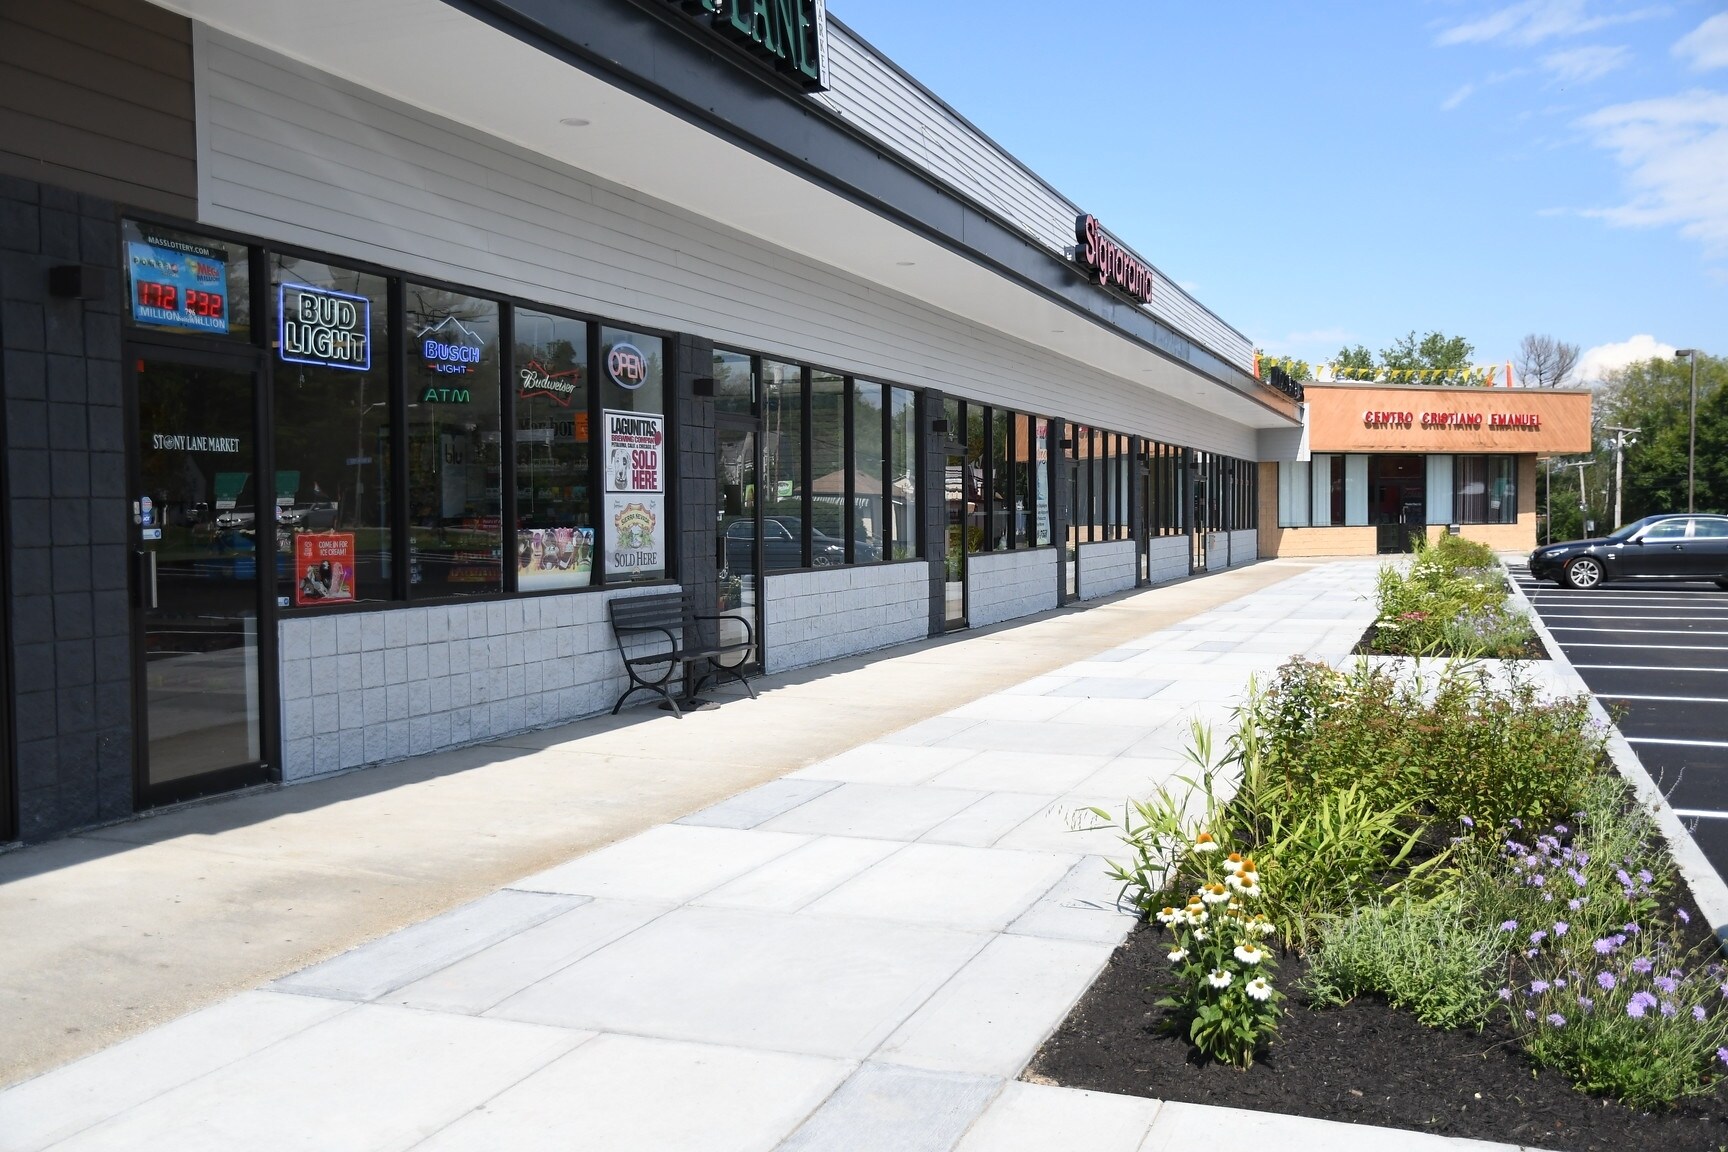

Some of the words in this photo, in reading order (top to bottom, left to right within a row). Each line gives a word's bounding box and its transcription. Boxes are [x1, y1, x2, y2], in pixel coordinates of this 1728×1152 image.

[148, 236, 210, 256] MASSLOTTERY.COM
[1085, 214, 1152, 304] Signarama
[142, 283, 176, 311] 172
[186, 290, 222, 318] 232
[140, 306, 180, 321] MILLION
[189, 315, 226, 329] MILLION
[299, 293, 357, 331] BUD
[286, 321, 367, 362] LIGHT
[424, 340, 481, 364] BUSCH
[436, 363, 467, 375] LIGHT
[609, 351, 644, 380] OPEN
[520, 368, 577, 394] Budweiser
[425, 388, 470, 403] ATM
[611, 417, 657, 437] LAGUNITAS
[1363, 411, 1414, 424] CENTRO
[1421, 412, 1483, 425] CRISTIANO
[1489, 413, 1542, 426] EMANUEL
[153, 434, 185, 451] STONY
[186, 436, 208, 451] LANE
[208, 437, 240, 453] MARKET
[632, 449, 658, 470] SOLD
[632, 469, 658, 490] HERE
[318, 541, 332, 549] COME
[339, 540, 349, 548] FOR
[320, 548, 328, 556] ICE
[614, 552, 636, 567] SOLD
[636, 551, 658, 566] HERE
